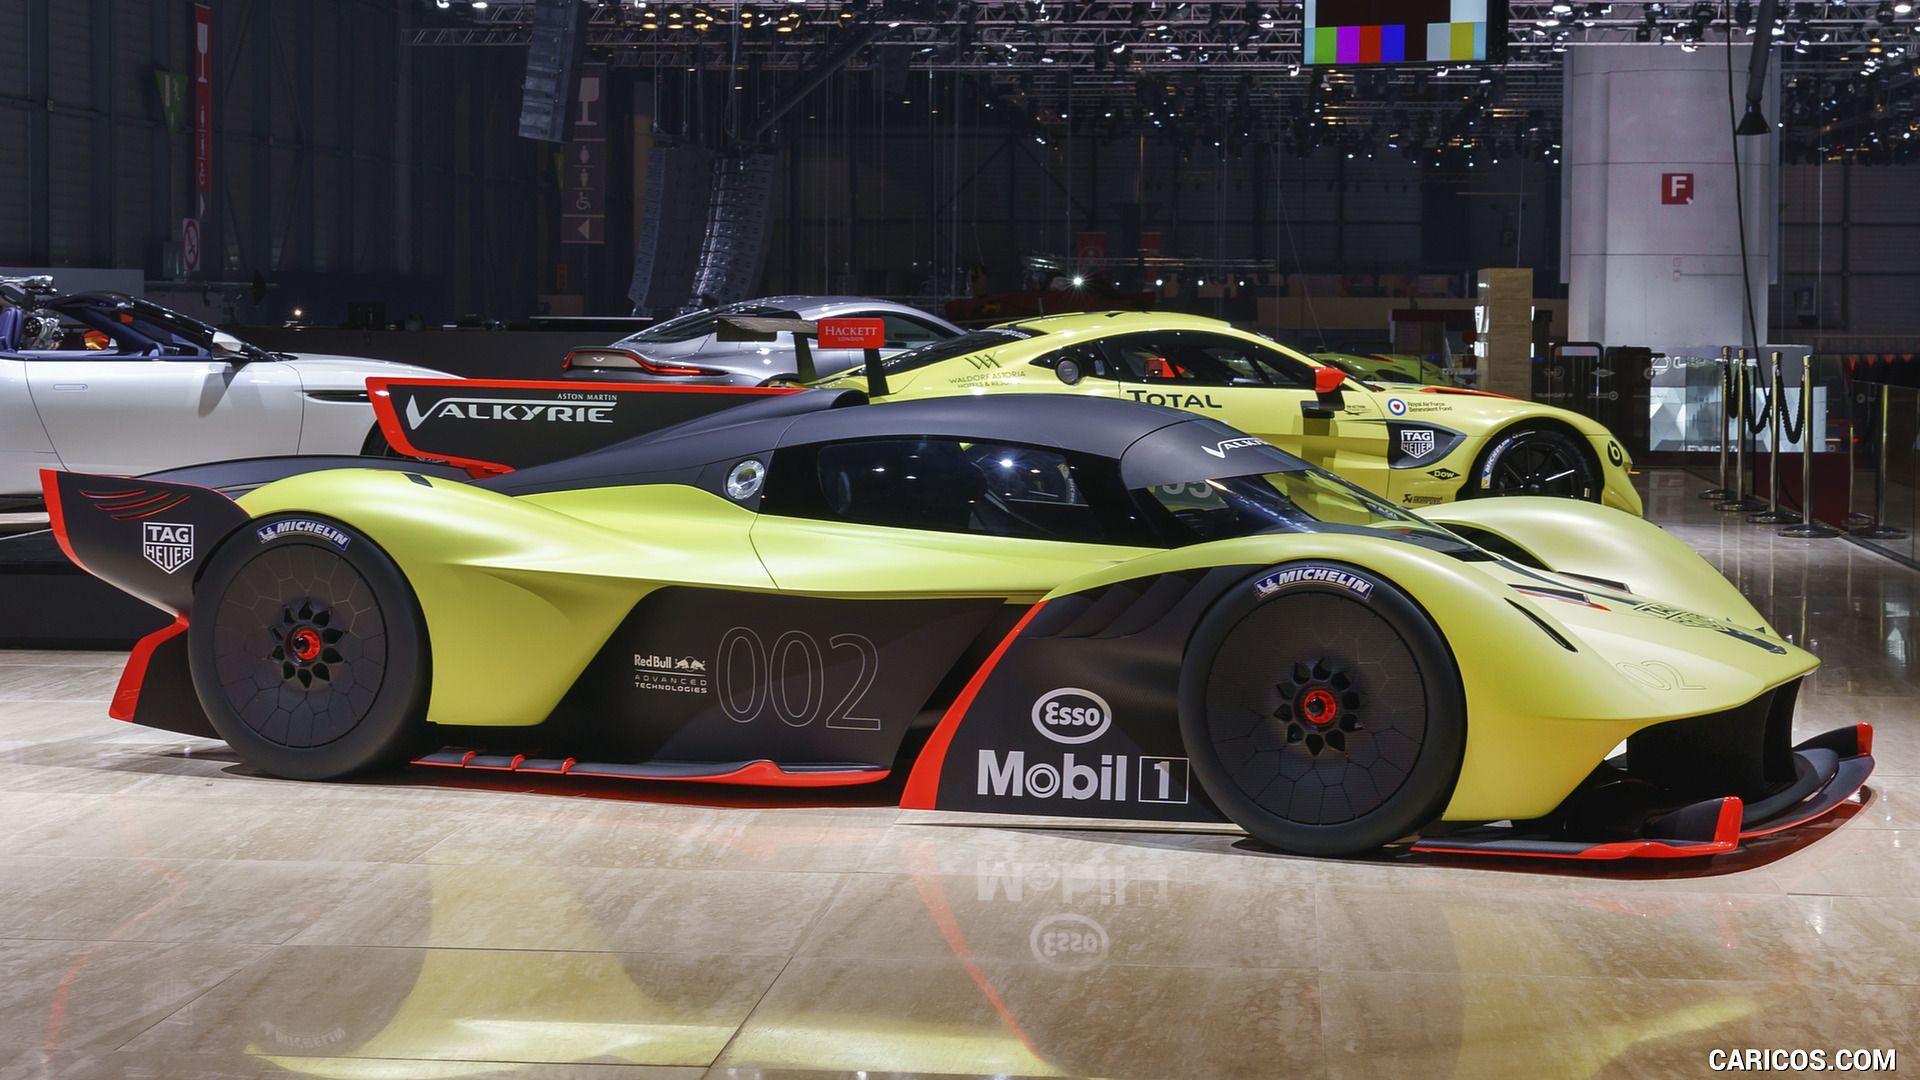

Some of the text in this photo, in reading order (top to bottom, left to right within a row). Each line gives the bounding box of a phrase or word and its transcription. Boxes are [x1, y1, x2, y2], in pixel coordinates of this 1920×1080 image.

[1671, 176, 1688, 198] F
[825, 326, 878, 336] HACKETT
[948, 373, 990, 384] WALDORF
[992, 370, 1026, 380] ASTORIA
[587, 393, 618, 401] MARTIN
[405, 394, 617, 431] VALKYRIE
[1404, 432, 1431, 441] TAG
[1402, 442, 1432, 456] HEUER
[147, 525, 190, 543] TAG
[276, 519, 349, 546] MICHELIN
[146, 544, 191, 571] HEUER
[1278, 569, 1371, 594] MICHELIN
[634, 673, 708, 686] ADVANCED
[634, 681, 708, 694] TECHNOLOGIES
[716, 626, 881, 731] 002
[1044, 701, 1100, 727] Esso
[977, 749, 1170, 801] Mobil 1
